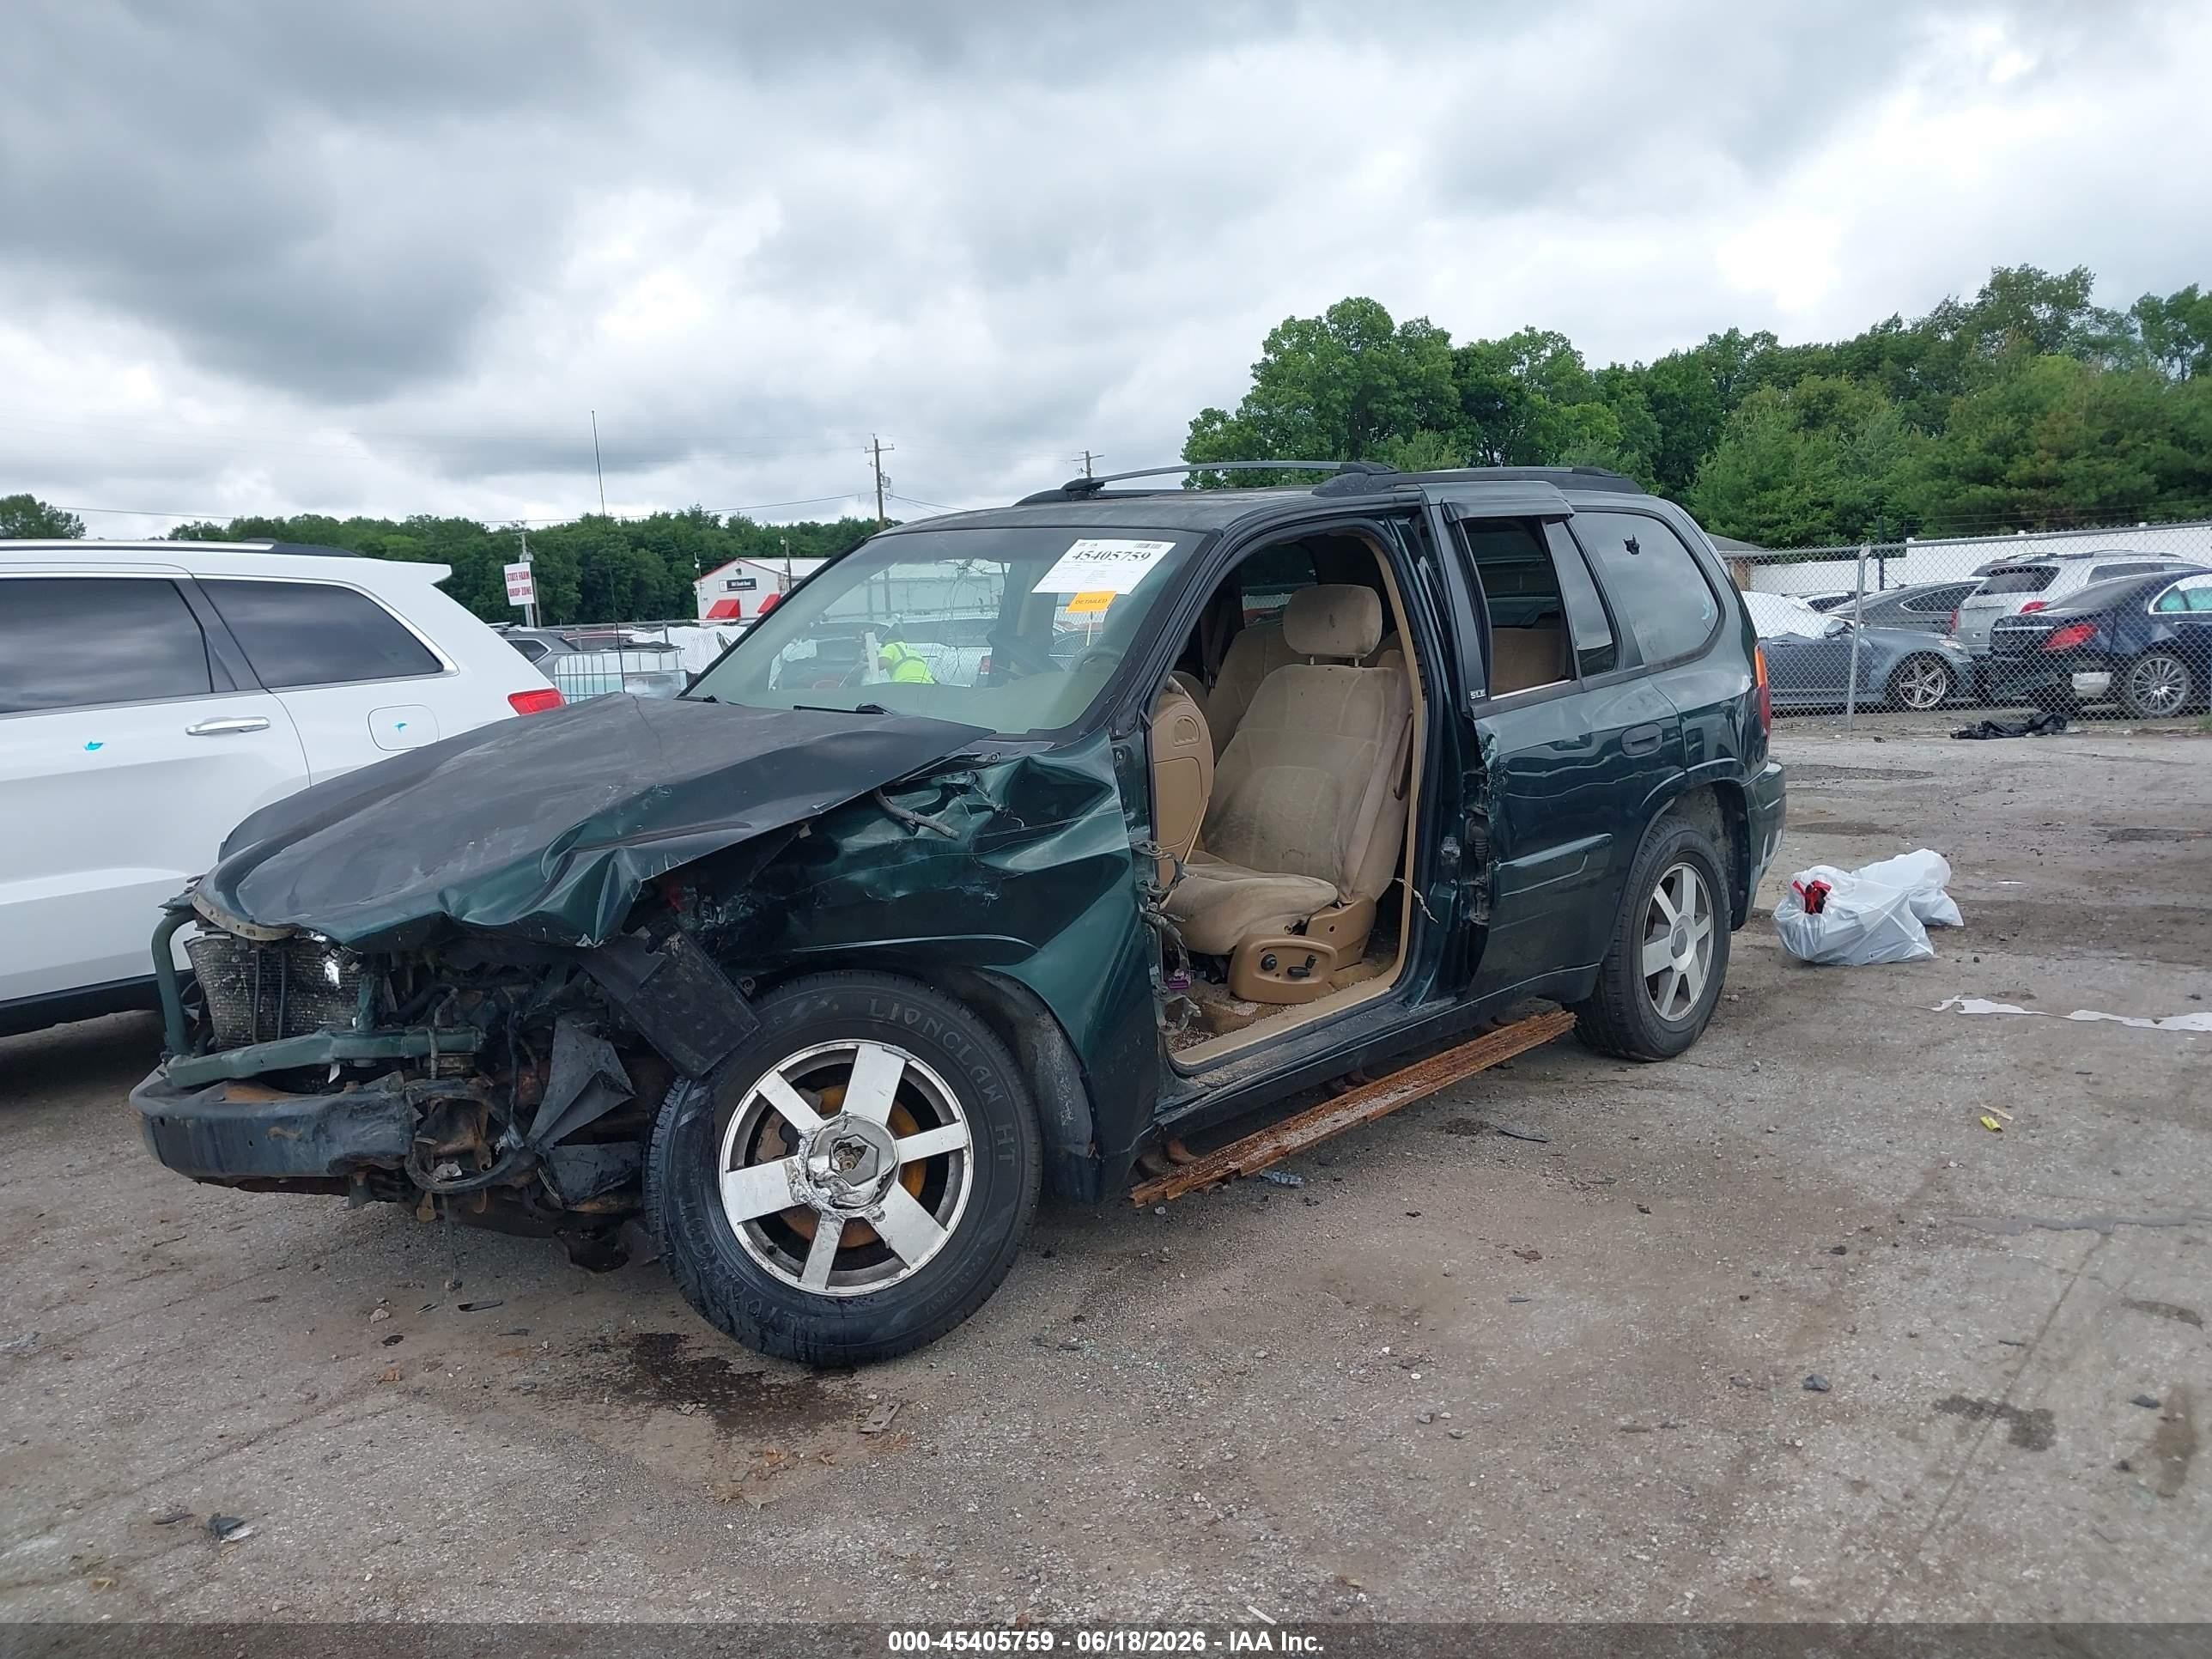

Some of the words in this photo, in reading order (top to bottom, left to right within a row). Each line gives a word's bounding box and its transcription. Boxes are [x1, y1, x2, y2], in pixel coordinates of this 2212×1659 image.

[1073, 550, 1152, 562] 45405759
[507, 572, 518, 582] STATE
[519, 570, 530, 580] FARM
[508, 587, 520, 597] DROP
[521, 586, 532, 595] ZONE
[868, 998, 1003, 1104] LIONCLAW
[995, 1123, 1015, 1167] HT
